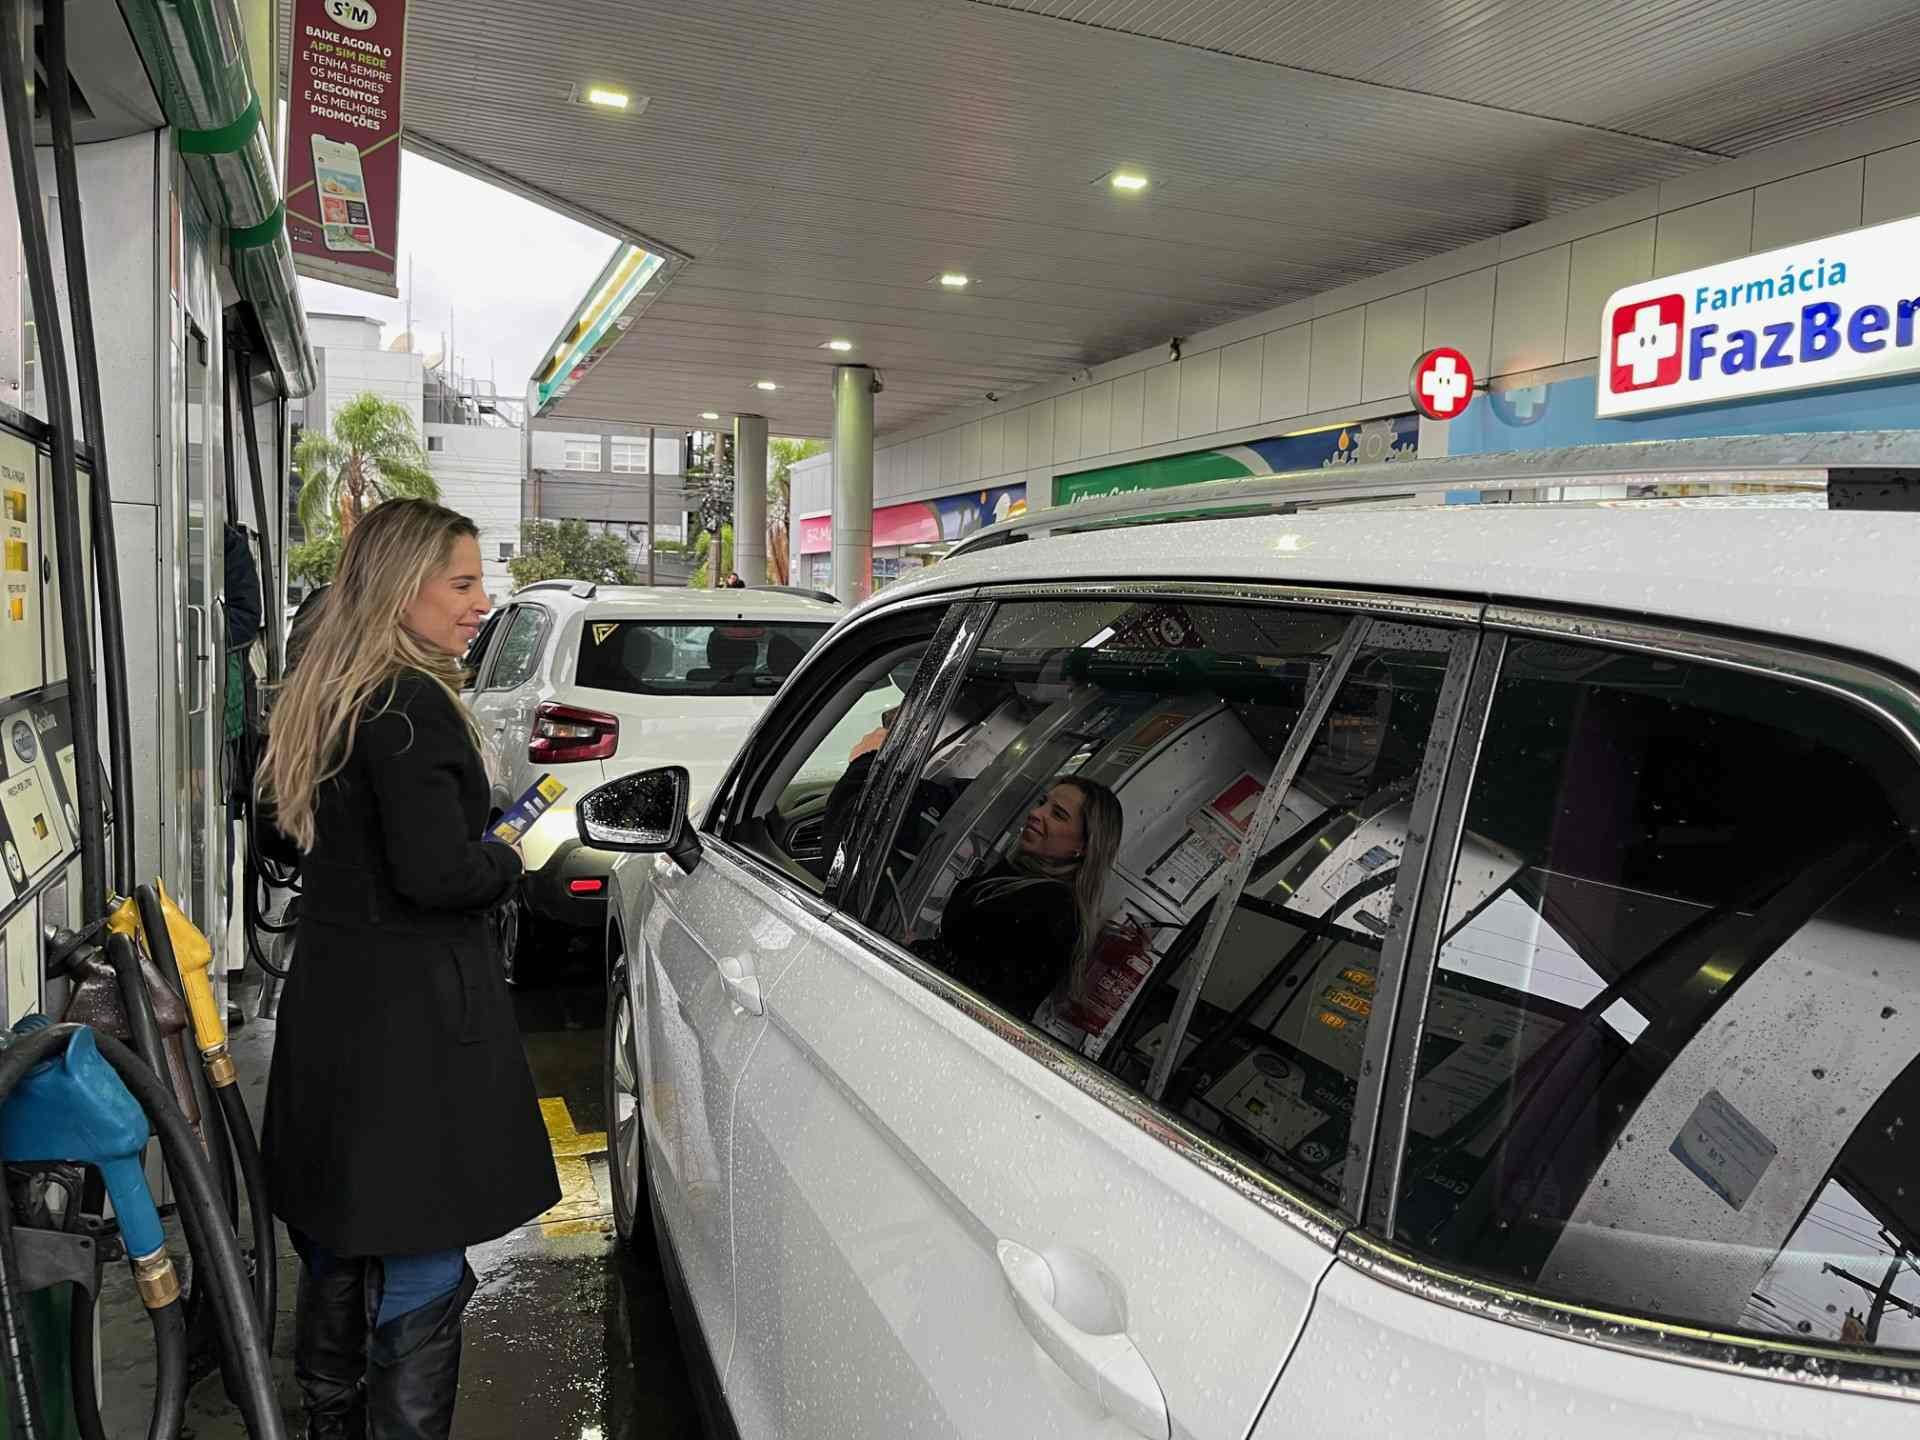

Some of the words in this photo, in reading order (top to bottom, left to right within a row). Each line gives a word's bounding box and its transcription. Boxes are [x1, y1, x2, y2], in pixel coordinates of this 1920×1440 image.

[305, 25, 341, 43] BAIXE
[342, 36, 381, 55] AGORA
[383, 47, 392, 57] O
[310, 40, 334, 53] APP
[335, 47, 356, 60] SIM
[358, 53, 387, 69] REDE
[303, 50, 310, 61] E
[312, 52, 349, 71] TENHA
[350, 63, 393, 83] SEMPRE
[310, 66, 326, 78] OS
[327, 70, 384, 94] MELHORES
[304, 90, 312, 100] E
[313, 93, 329, 104] AS
[330, 96, 388, 120] MELHORES
[313, 79, 380, 105] DESCONTOS
[310, 104, 381, 131] PROMOÇÕES
[1695, 258, 1847, 314] Farmácia
